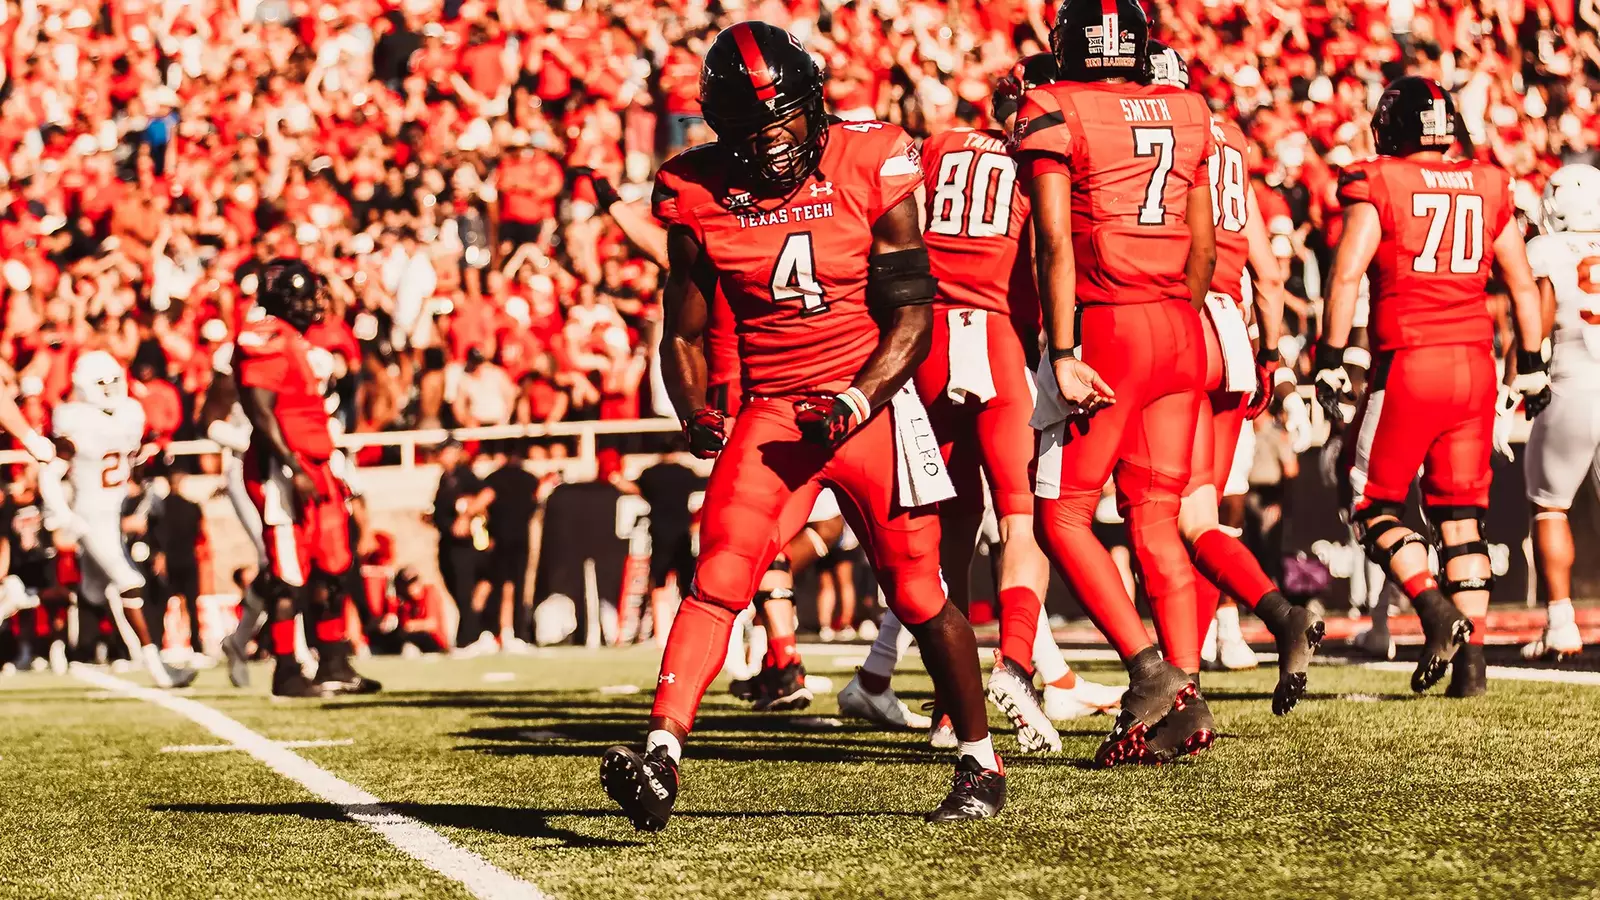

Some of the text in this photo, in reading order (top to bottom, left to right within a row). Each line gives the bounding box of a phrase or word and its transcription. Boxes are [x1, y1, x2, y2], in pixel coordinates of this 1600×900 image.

[1119, 98, 1172, 121] SMITH
[737, 202, 834, 228] TEXAS TECH
[928, 150, 1017, 237] 80
[1131, 126, 1176, 226] 7
[770, 230, 830, 318] 4
[1412, 192, 1484, 274] 70
